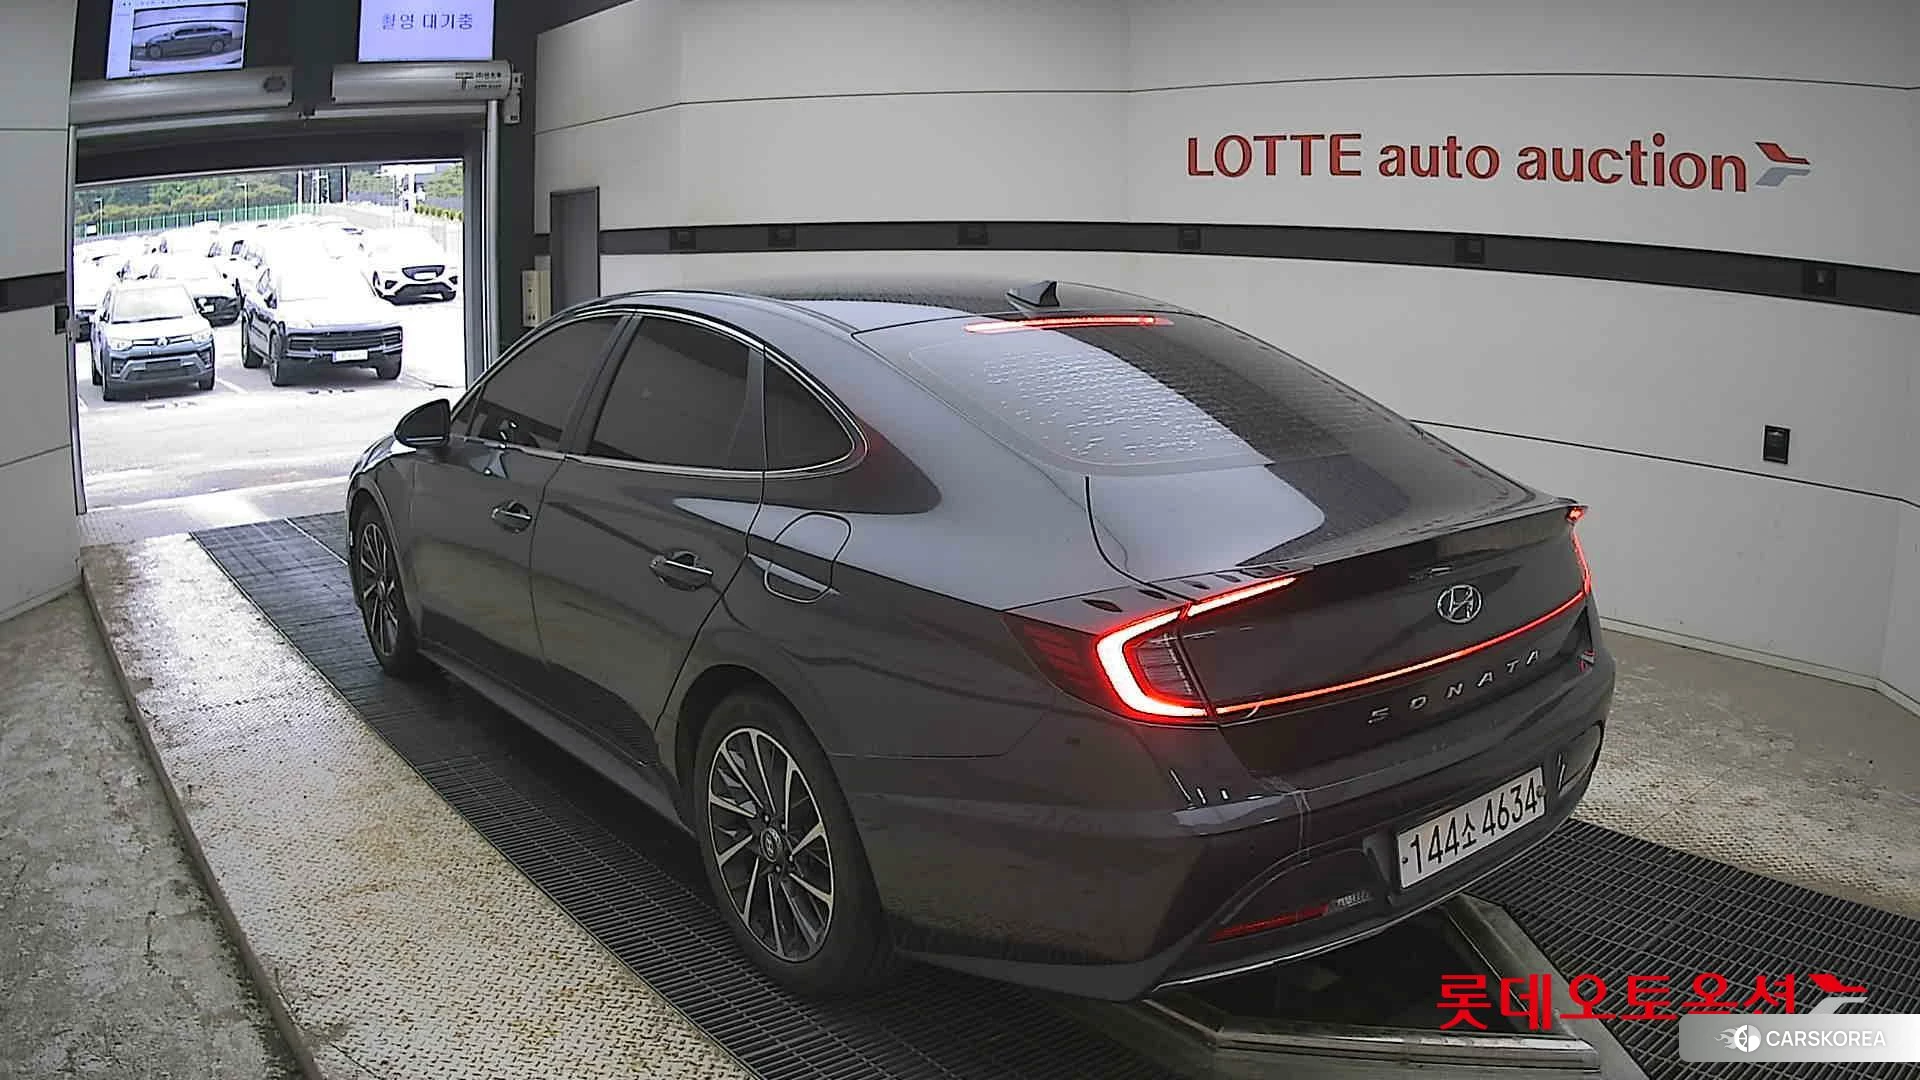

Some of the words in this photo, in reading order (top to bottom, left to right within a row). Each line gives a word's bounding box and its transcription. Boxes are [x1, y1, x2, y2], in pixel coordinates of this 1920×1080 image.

[423, 13, 473, 30] 대기중
[1187, 133, 1362, 177] LOTTE
[1378, 136, 1500, 180] auto
[1516, 132, 1747, 193] auction
[1367, 649, 1540, 725] SONATA
